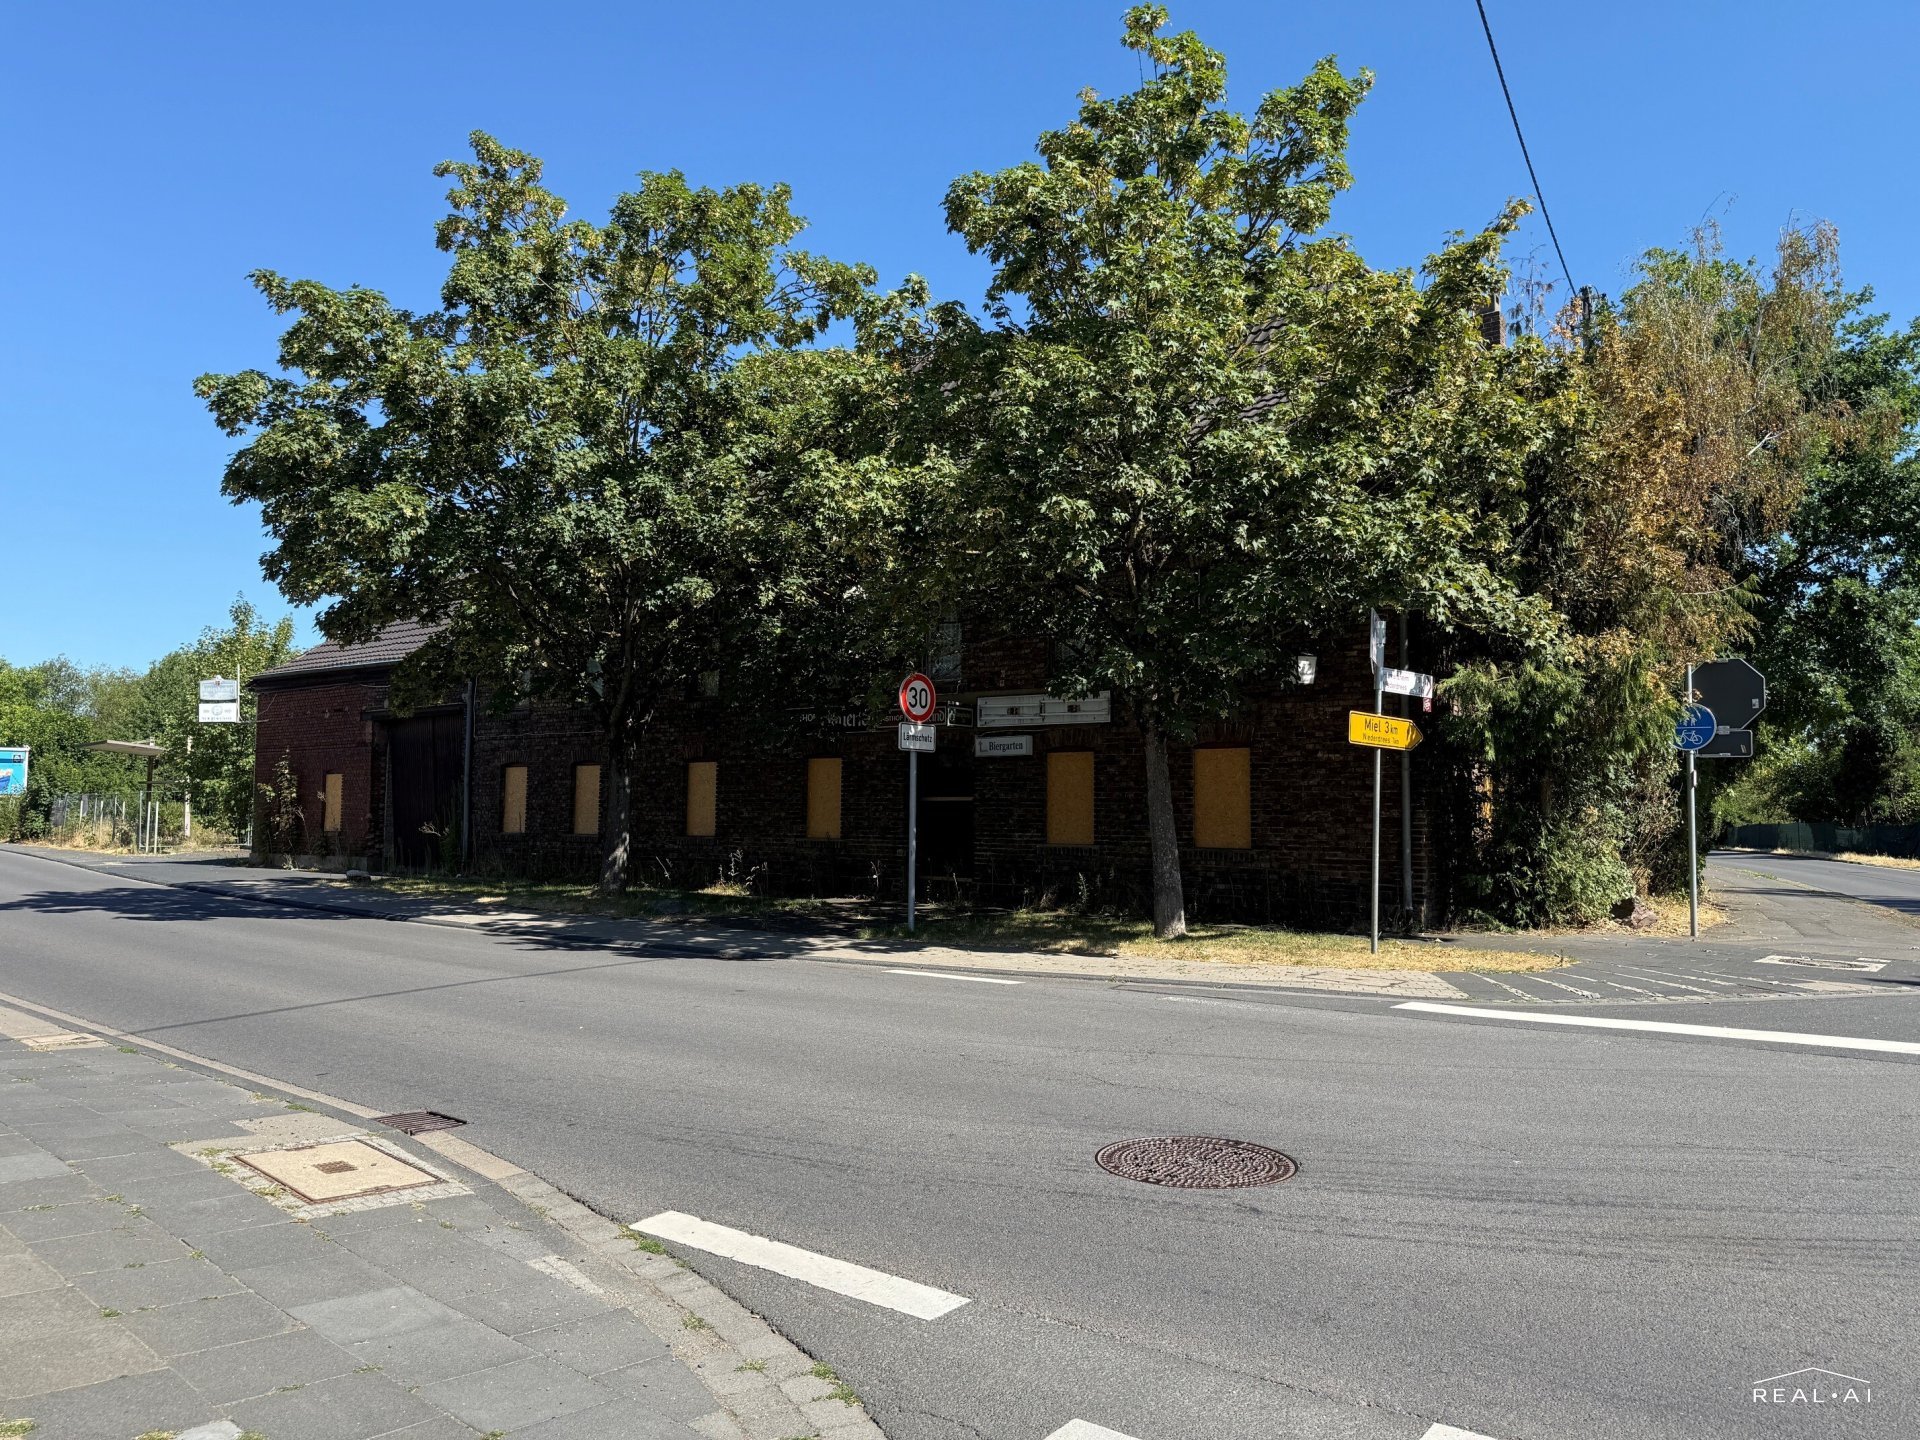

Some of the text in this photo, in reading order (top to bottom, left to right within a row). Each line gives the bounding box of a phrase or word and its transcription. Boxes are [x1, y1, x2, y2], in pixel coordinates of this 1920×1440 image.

[908, 687, 928, 709] 30
[1364, 718, 1381, 733] Miel
[903, 732, 933, 743] Lärmschutz
[1362, 733, 1391, 744] Niederdrees
[988, 741, 1023, 752] Biergarten
